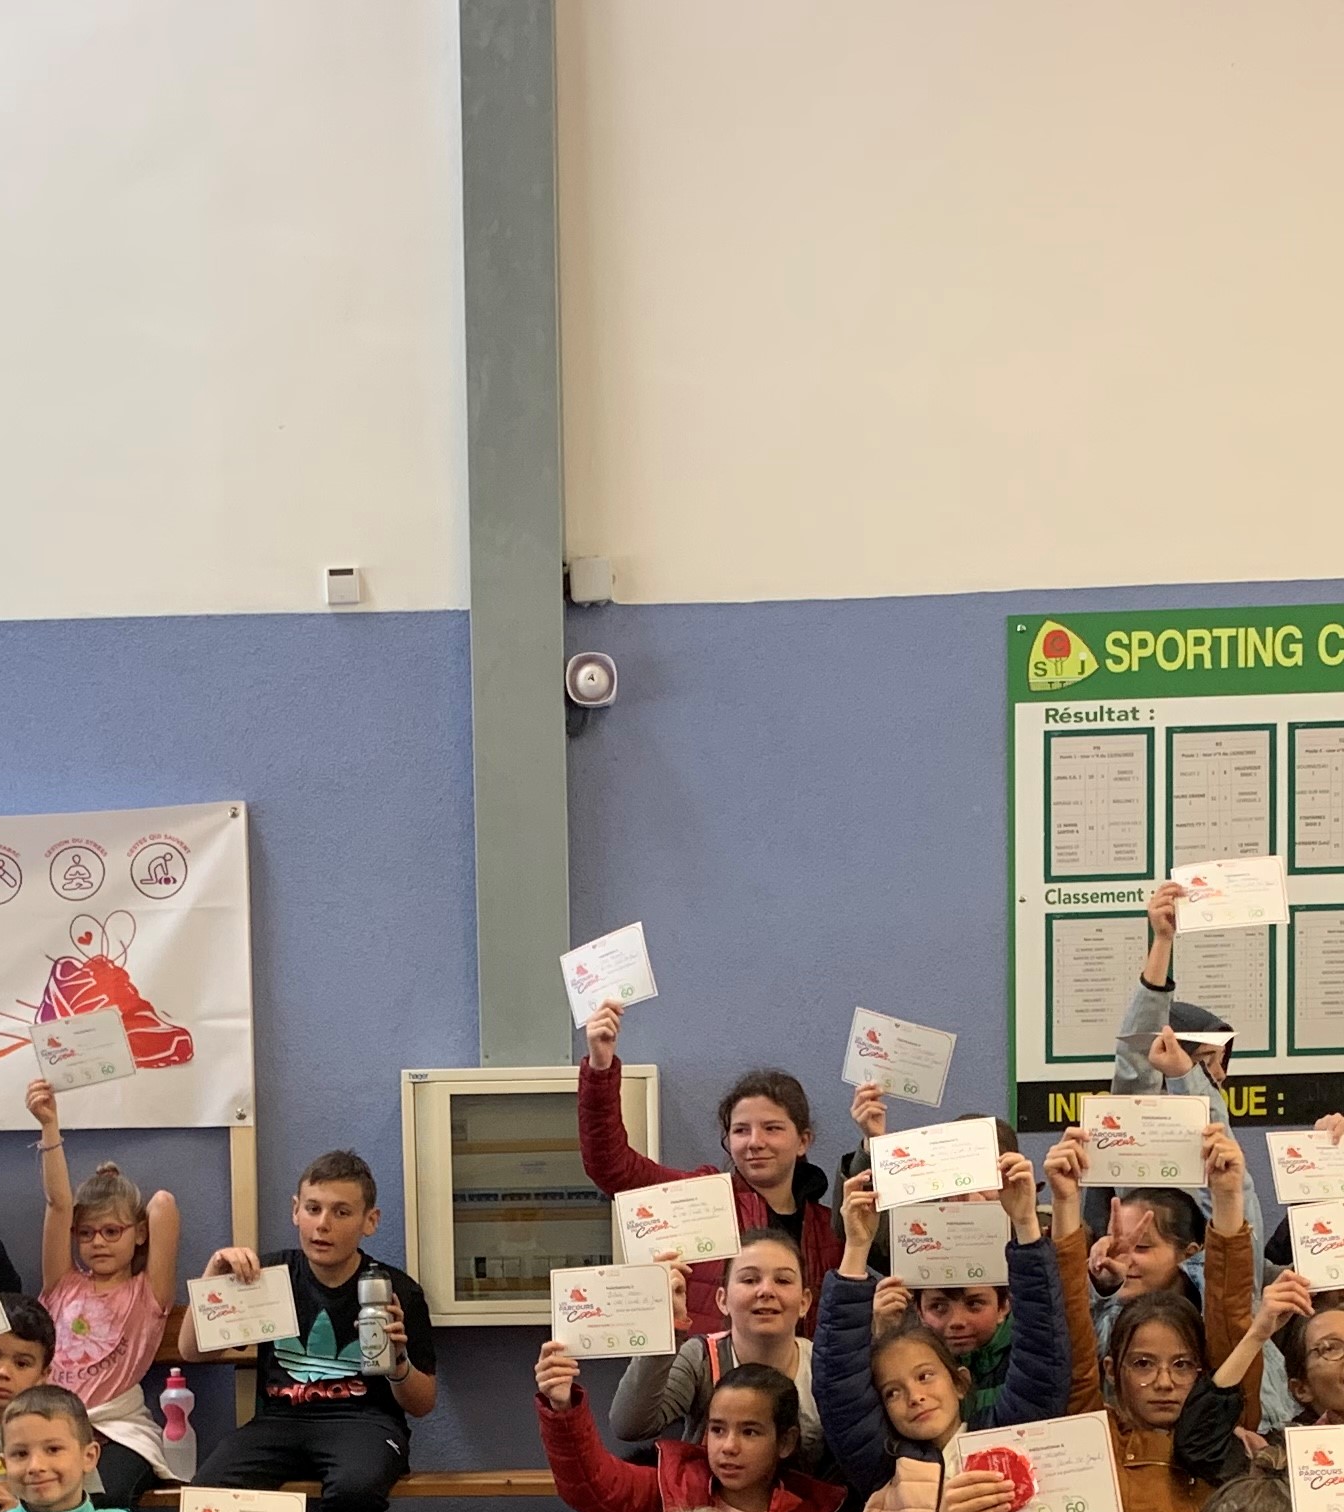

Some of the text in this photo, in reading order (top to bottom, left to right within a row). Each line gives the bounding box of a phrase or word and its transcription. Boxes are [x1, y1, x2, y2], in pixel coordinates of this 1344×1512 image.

[1106, 625, 1303, 674] SPORTING
[1044, 705, 1140, 724] Résultat
[1044, 888, 1144, 905] Classement
[620, 986, 634, 998] 60
[903, 1083, 918, 1094] 60
[1137, 1165, 1178, 1177] 5 60
[954, 1176, 972, 1188] 60
[697, 1241, 713, 1253] 60
[967, 1266, 983, 1278] 60
[261, 1323, 275, 1334] 60
[607, 1335, 646, 1348] 5 60
[1298, 1468, 1343, 1477] PARCOURS
